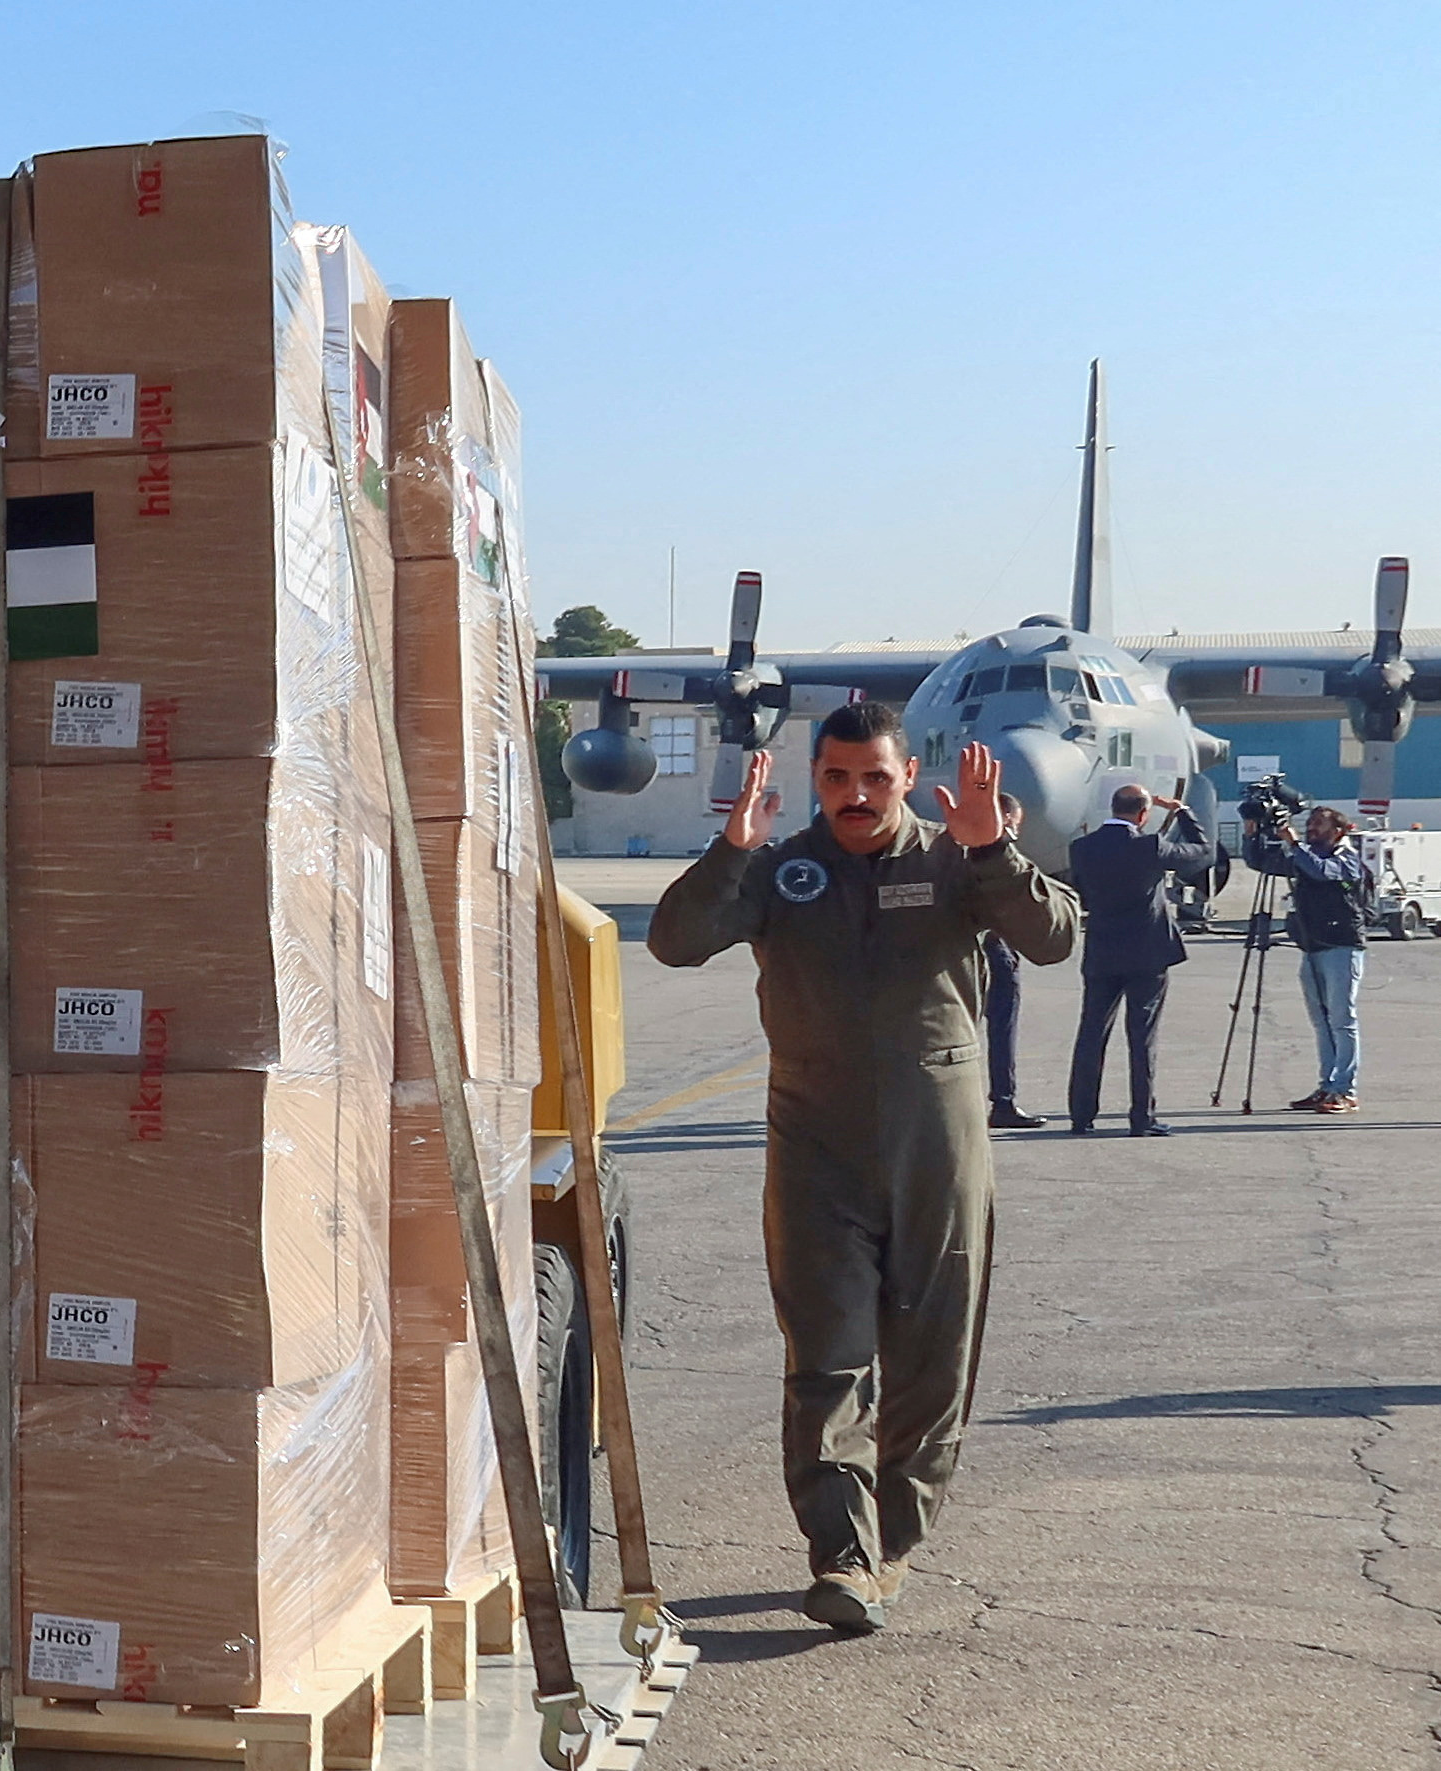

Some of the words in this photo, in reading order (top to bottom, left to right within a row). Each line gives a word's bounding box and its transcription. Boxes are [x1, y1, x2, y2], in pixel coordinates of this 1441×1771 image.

[52, 387, 107, 402] JHCO
[57, 693, 113, 709] JHCO
[59, 1001, 114, 1016] JHCO
[52, 1307, 108, 1324] JHCO
[35, 1628, 91, 1646] JHCO
